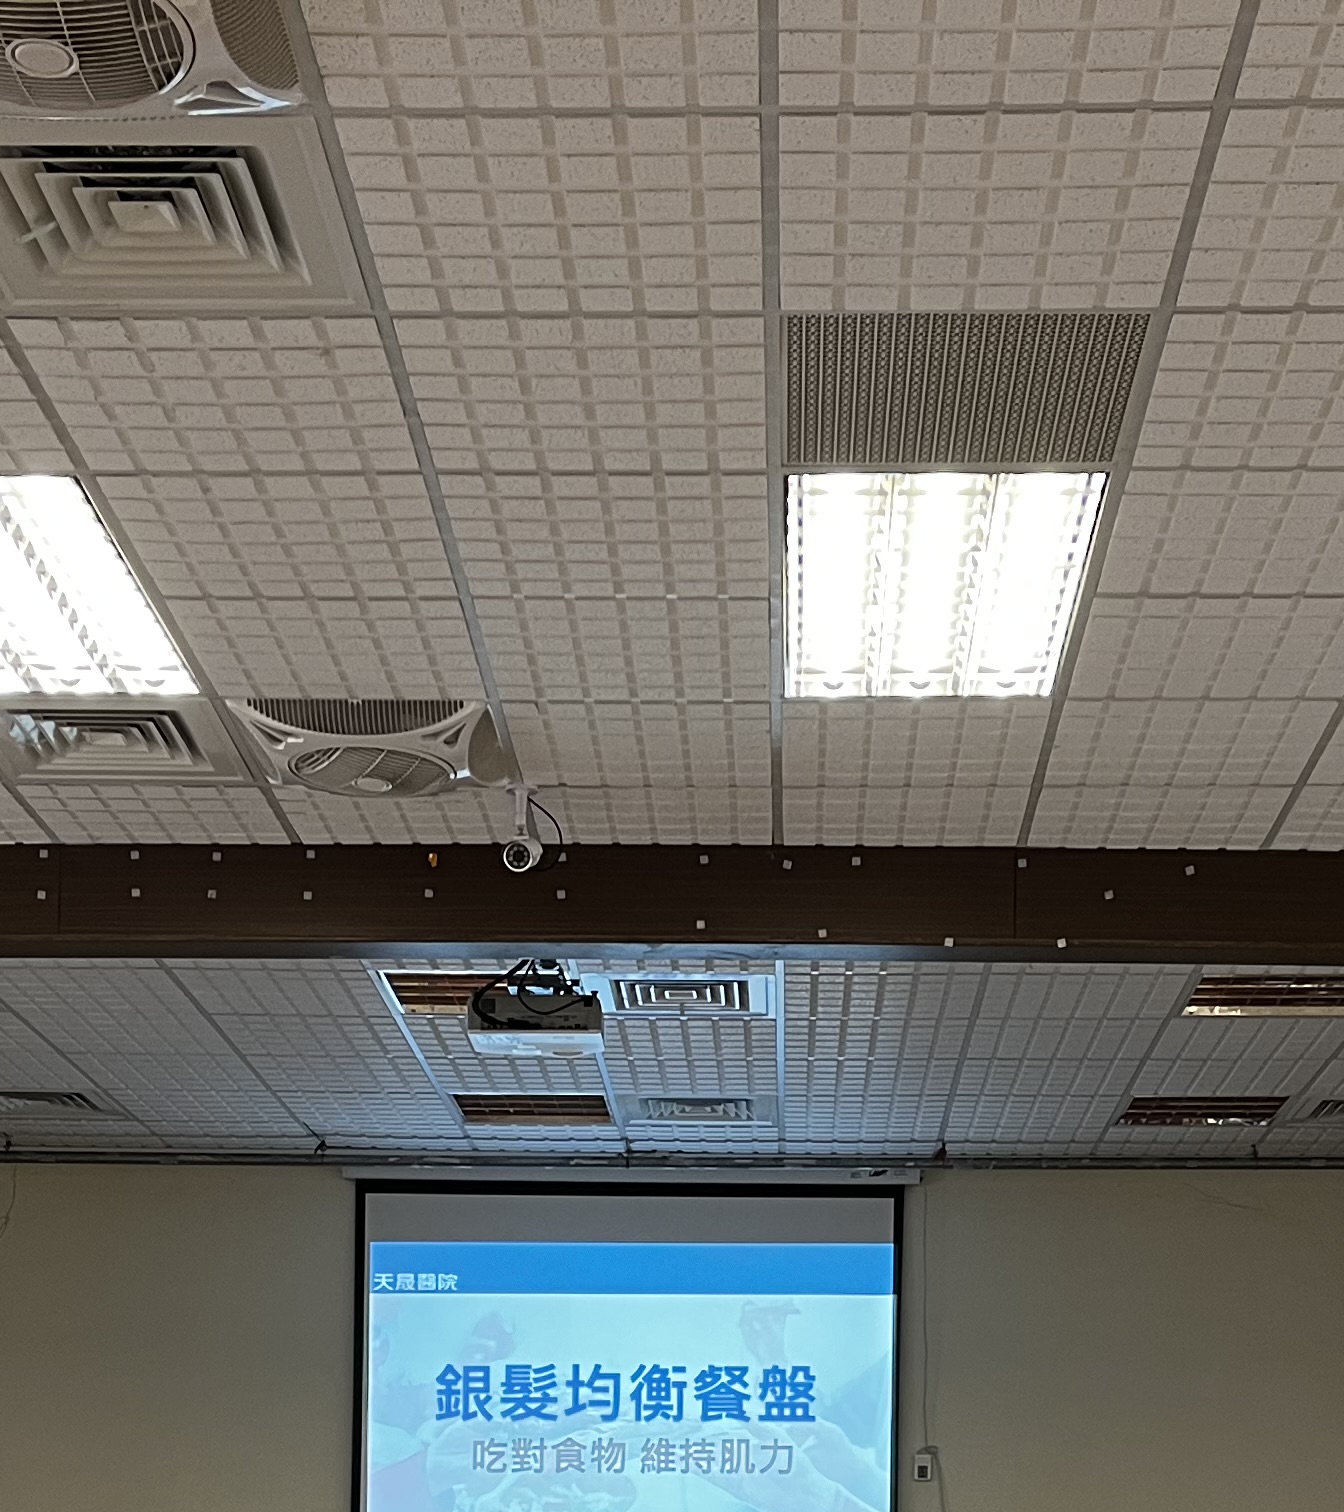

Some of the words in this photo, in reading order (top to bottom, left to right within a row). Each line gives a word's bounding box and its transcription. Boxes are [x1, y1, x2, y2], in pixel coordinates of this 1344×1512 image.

[373, 1273, 458, 1291] 天晟醫院
[435, 1363, 816, 1423] 銀髮均衡餐盤
[472, 1437, 626, 1475] 吃對食物
[640, 1437, 794, 1475] 維持肌力
